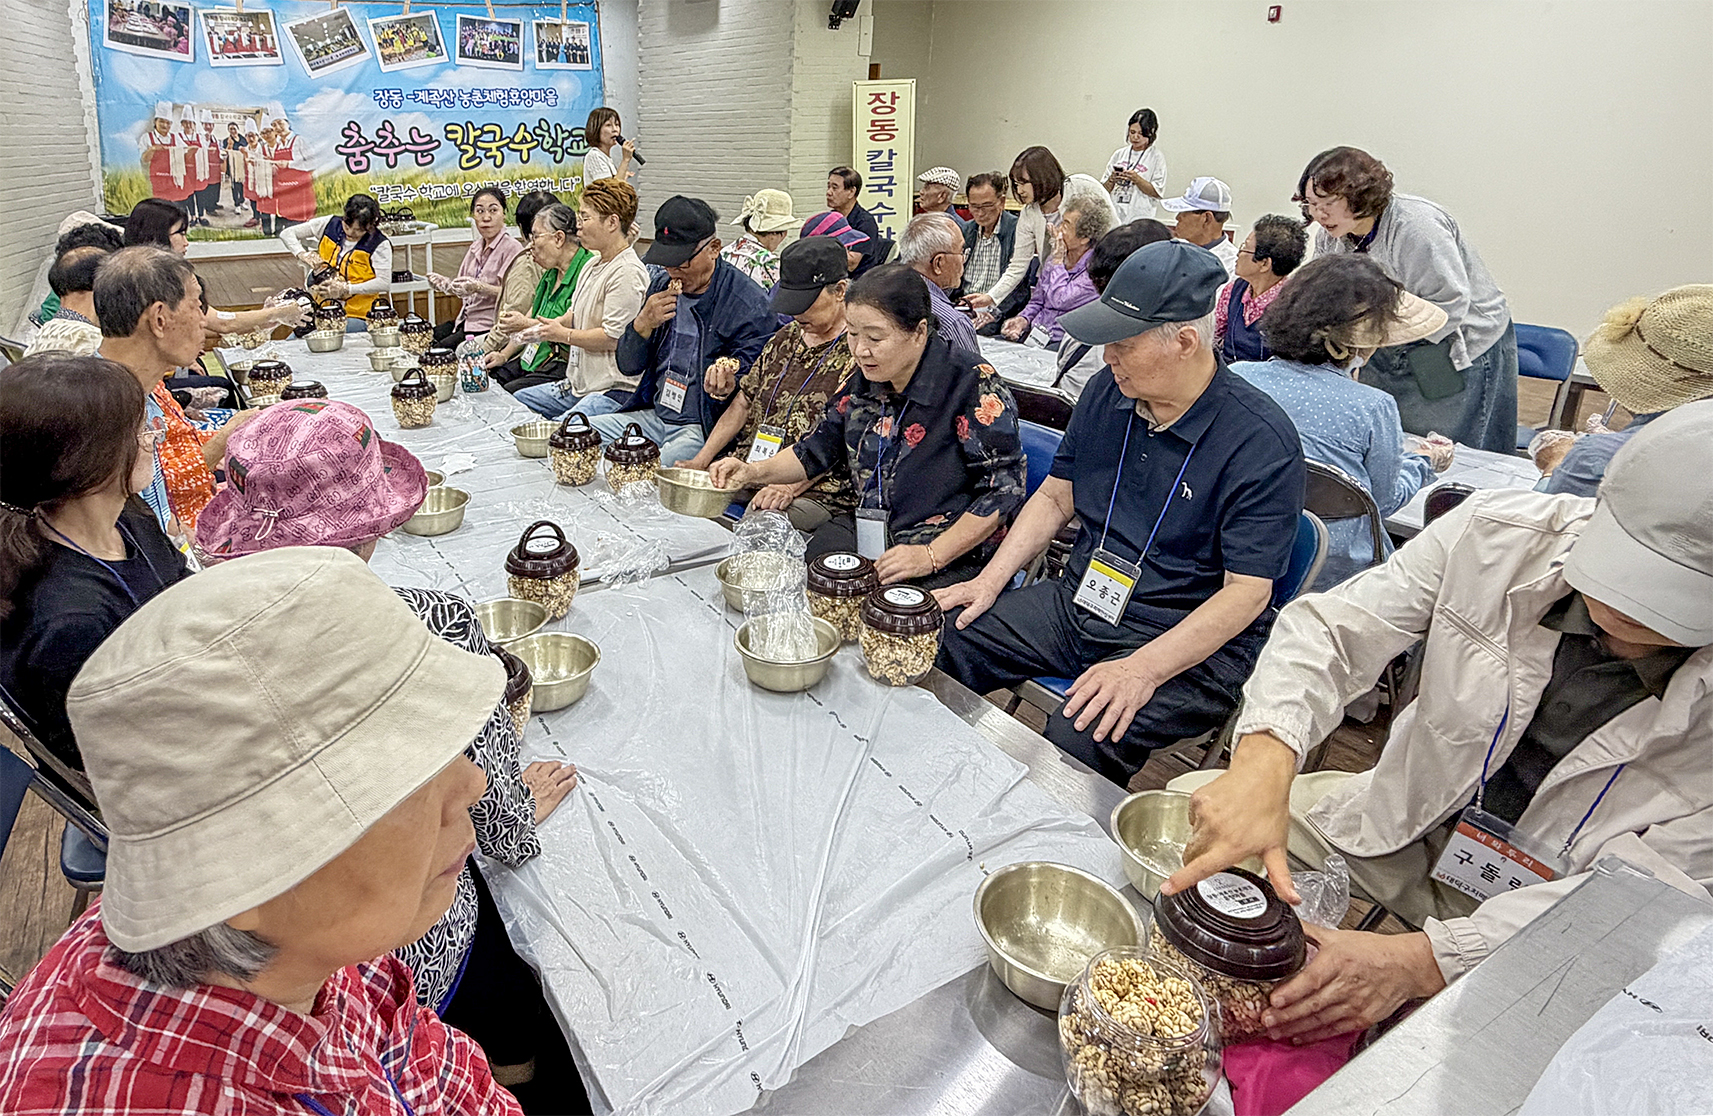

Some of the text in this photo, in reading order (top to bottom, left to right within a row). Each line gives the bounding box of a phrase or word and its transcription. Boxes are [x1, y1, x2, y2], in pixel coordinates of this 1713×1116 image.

[373, 88, 559, 109] 장동 -계족산 농촌체험휴양마을
[867, 91, 900, 142] 장동
[337, 119, 441, 174] 춤추는
[419, 183, 460, 200] 학교에
[1086, 580, 1121, 606] 오종근
[713, 982, 731, 1010] HYUNDAI
